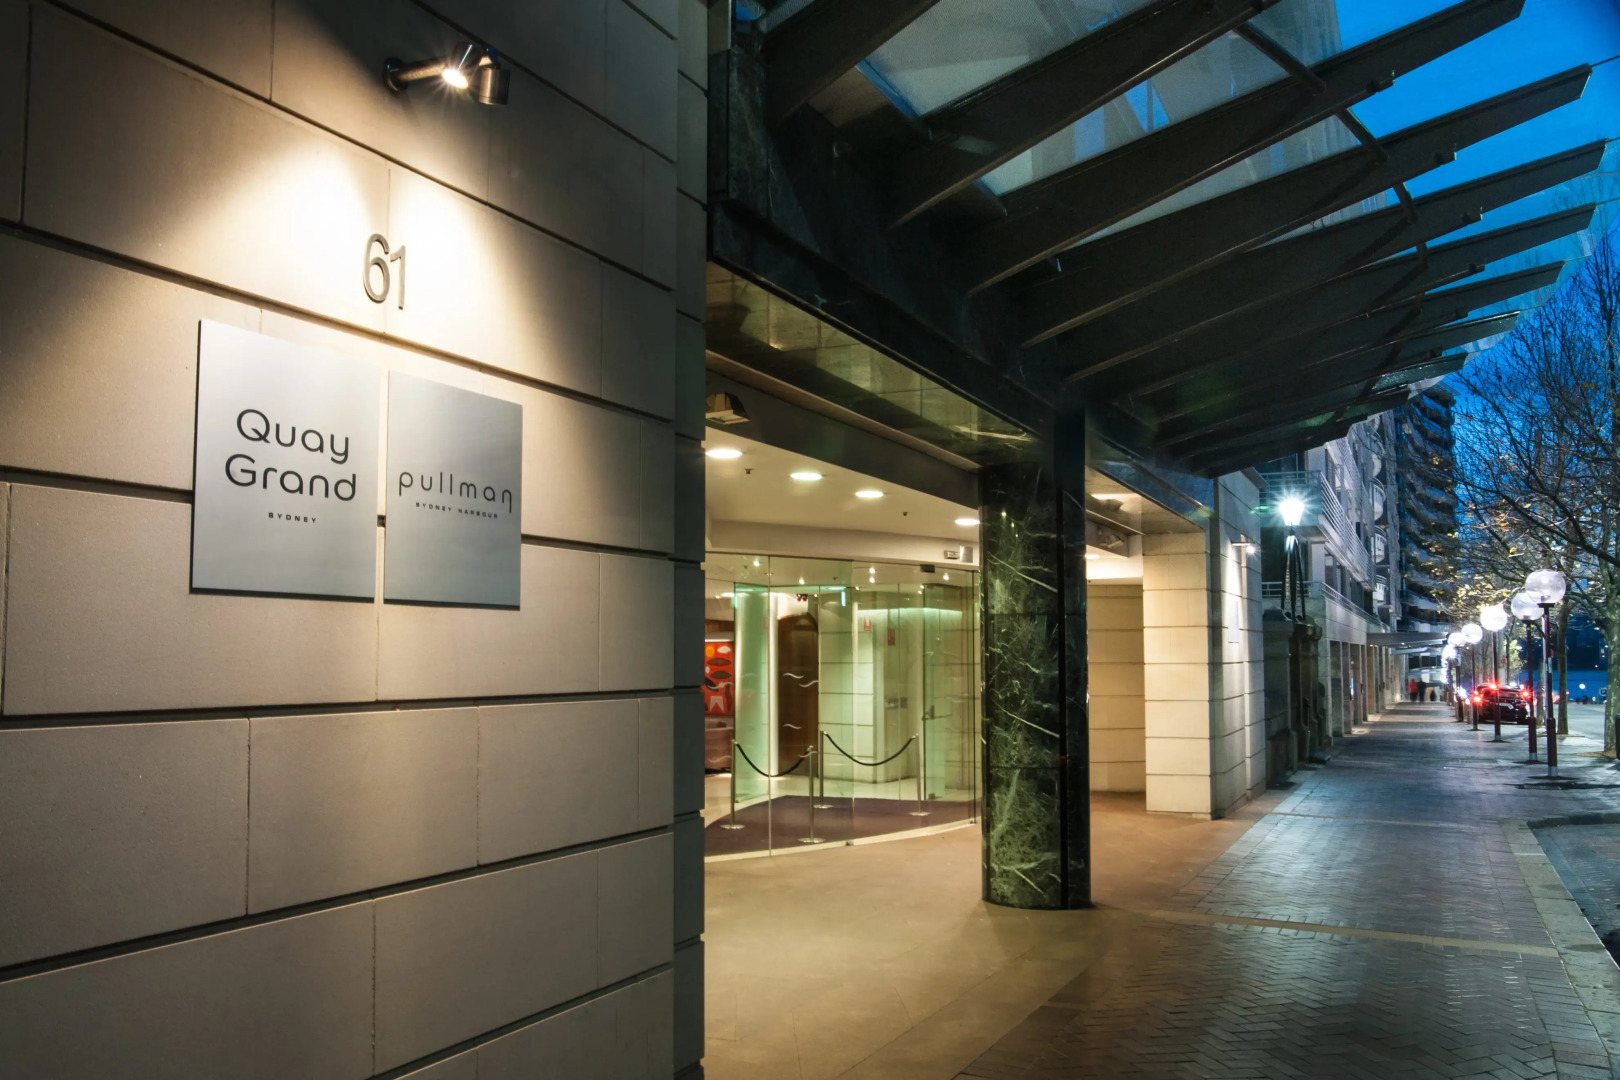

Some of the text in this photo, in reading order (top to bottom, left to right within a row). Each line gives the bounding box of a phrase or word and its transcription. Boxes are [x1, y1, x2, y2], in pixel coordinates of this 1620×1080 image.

[362, 233, 407, 310] 61
[236, 408, 350, 465] Quay
[224, 453, 357, 502] Grand
[398, 471, 513, 514] pullman
[457, 508, 499, 519] HARBOUR
